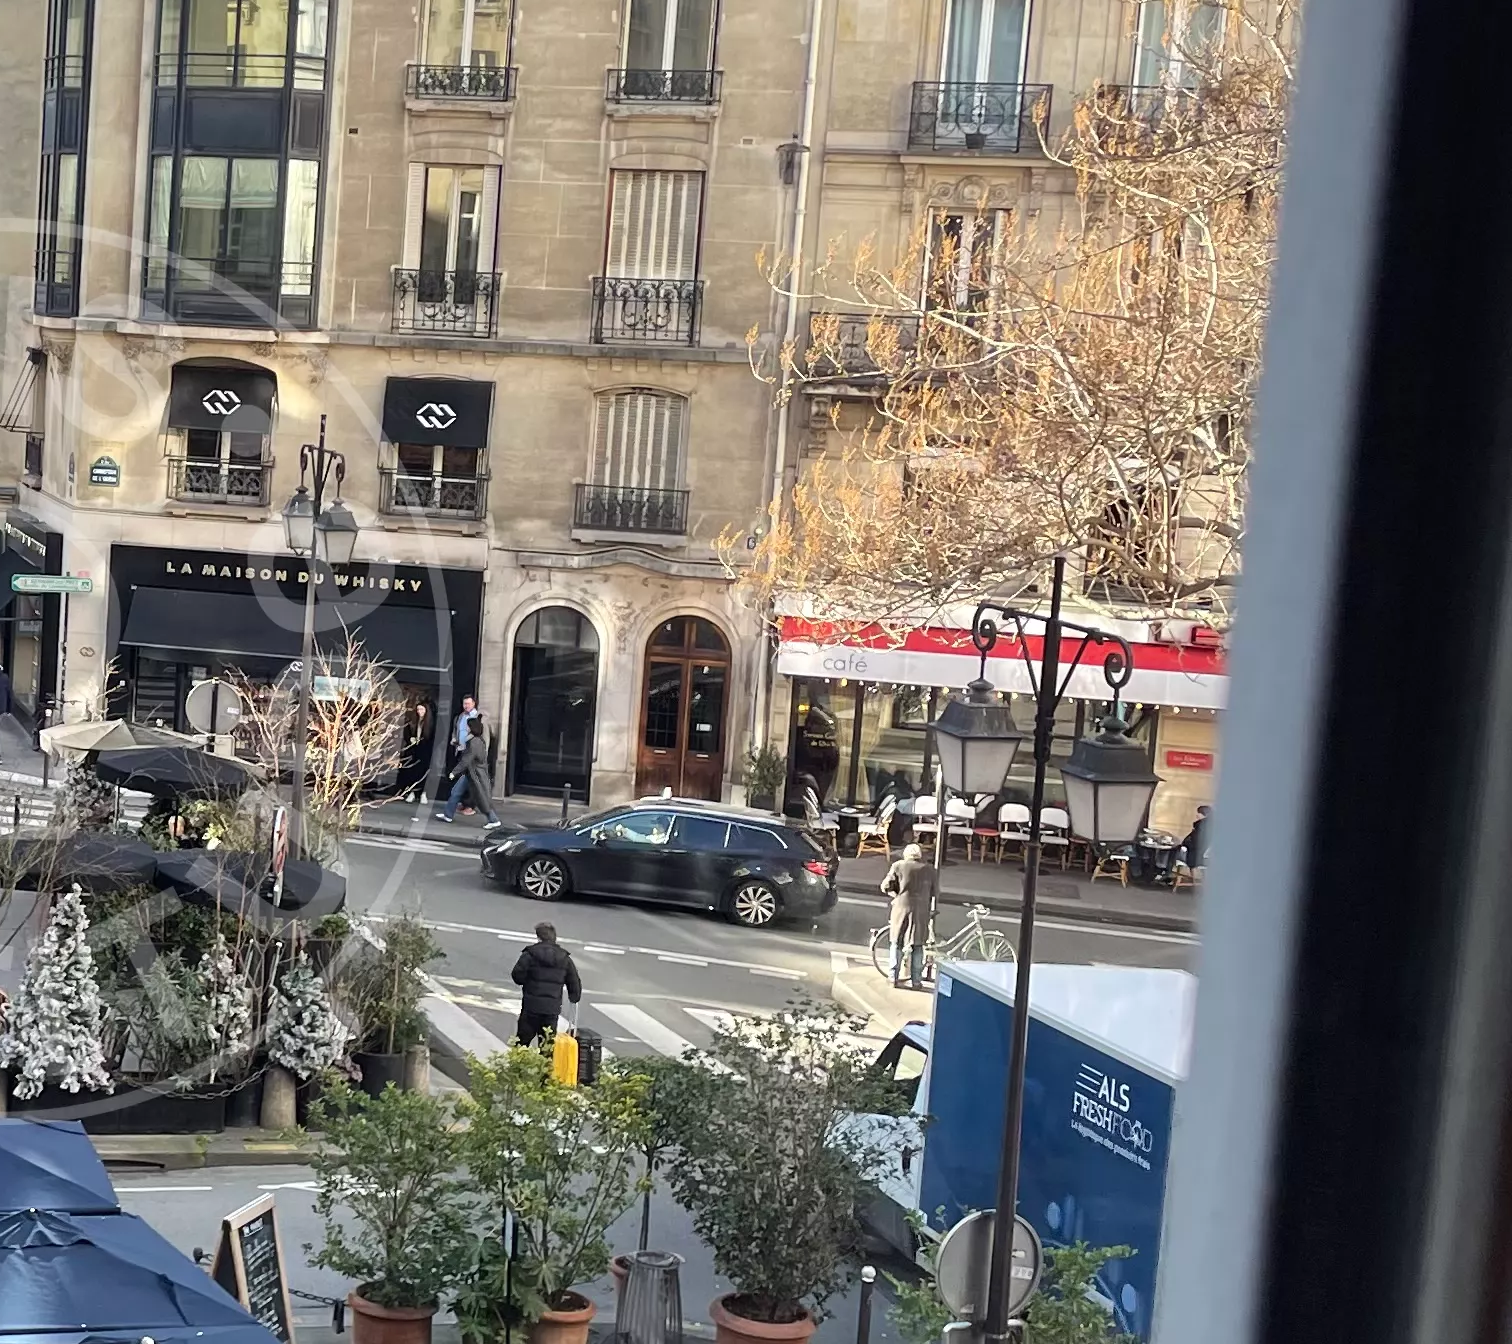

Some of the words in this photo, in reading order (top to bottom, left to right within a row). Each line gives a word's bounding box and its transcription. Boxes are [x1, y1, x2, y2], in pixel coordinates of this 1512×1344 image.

[166, 561, 192, 574] LA
[202, 564, 287, 581] MAISON
[298, 572, 324, 584] DU
[335, 574, 422, 592] WHISKY
[823, 653, 867, 672] café
[1098, 1075, 1130, 1112] ALS
